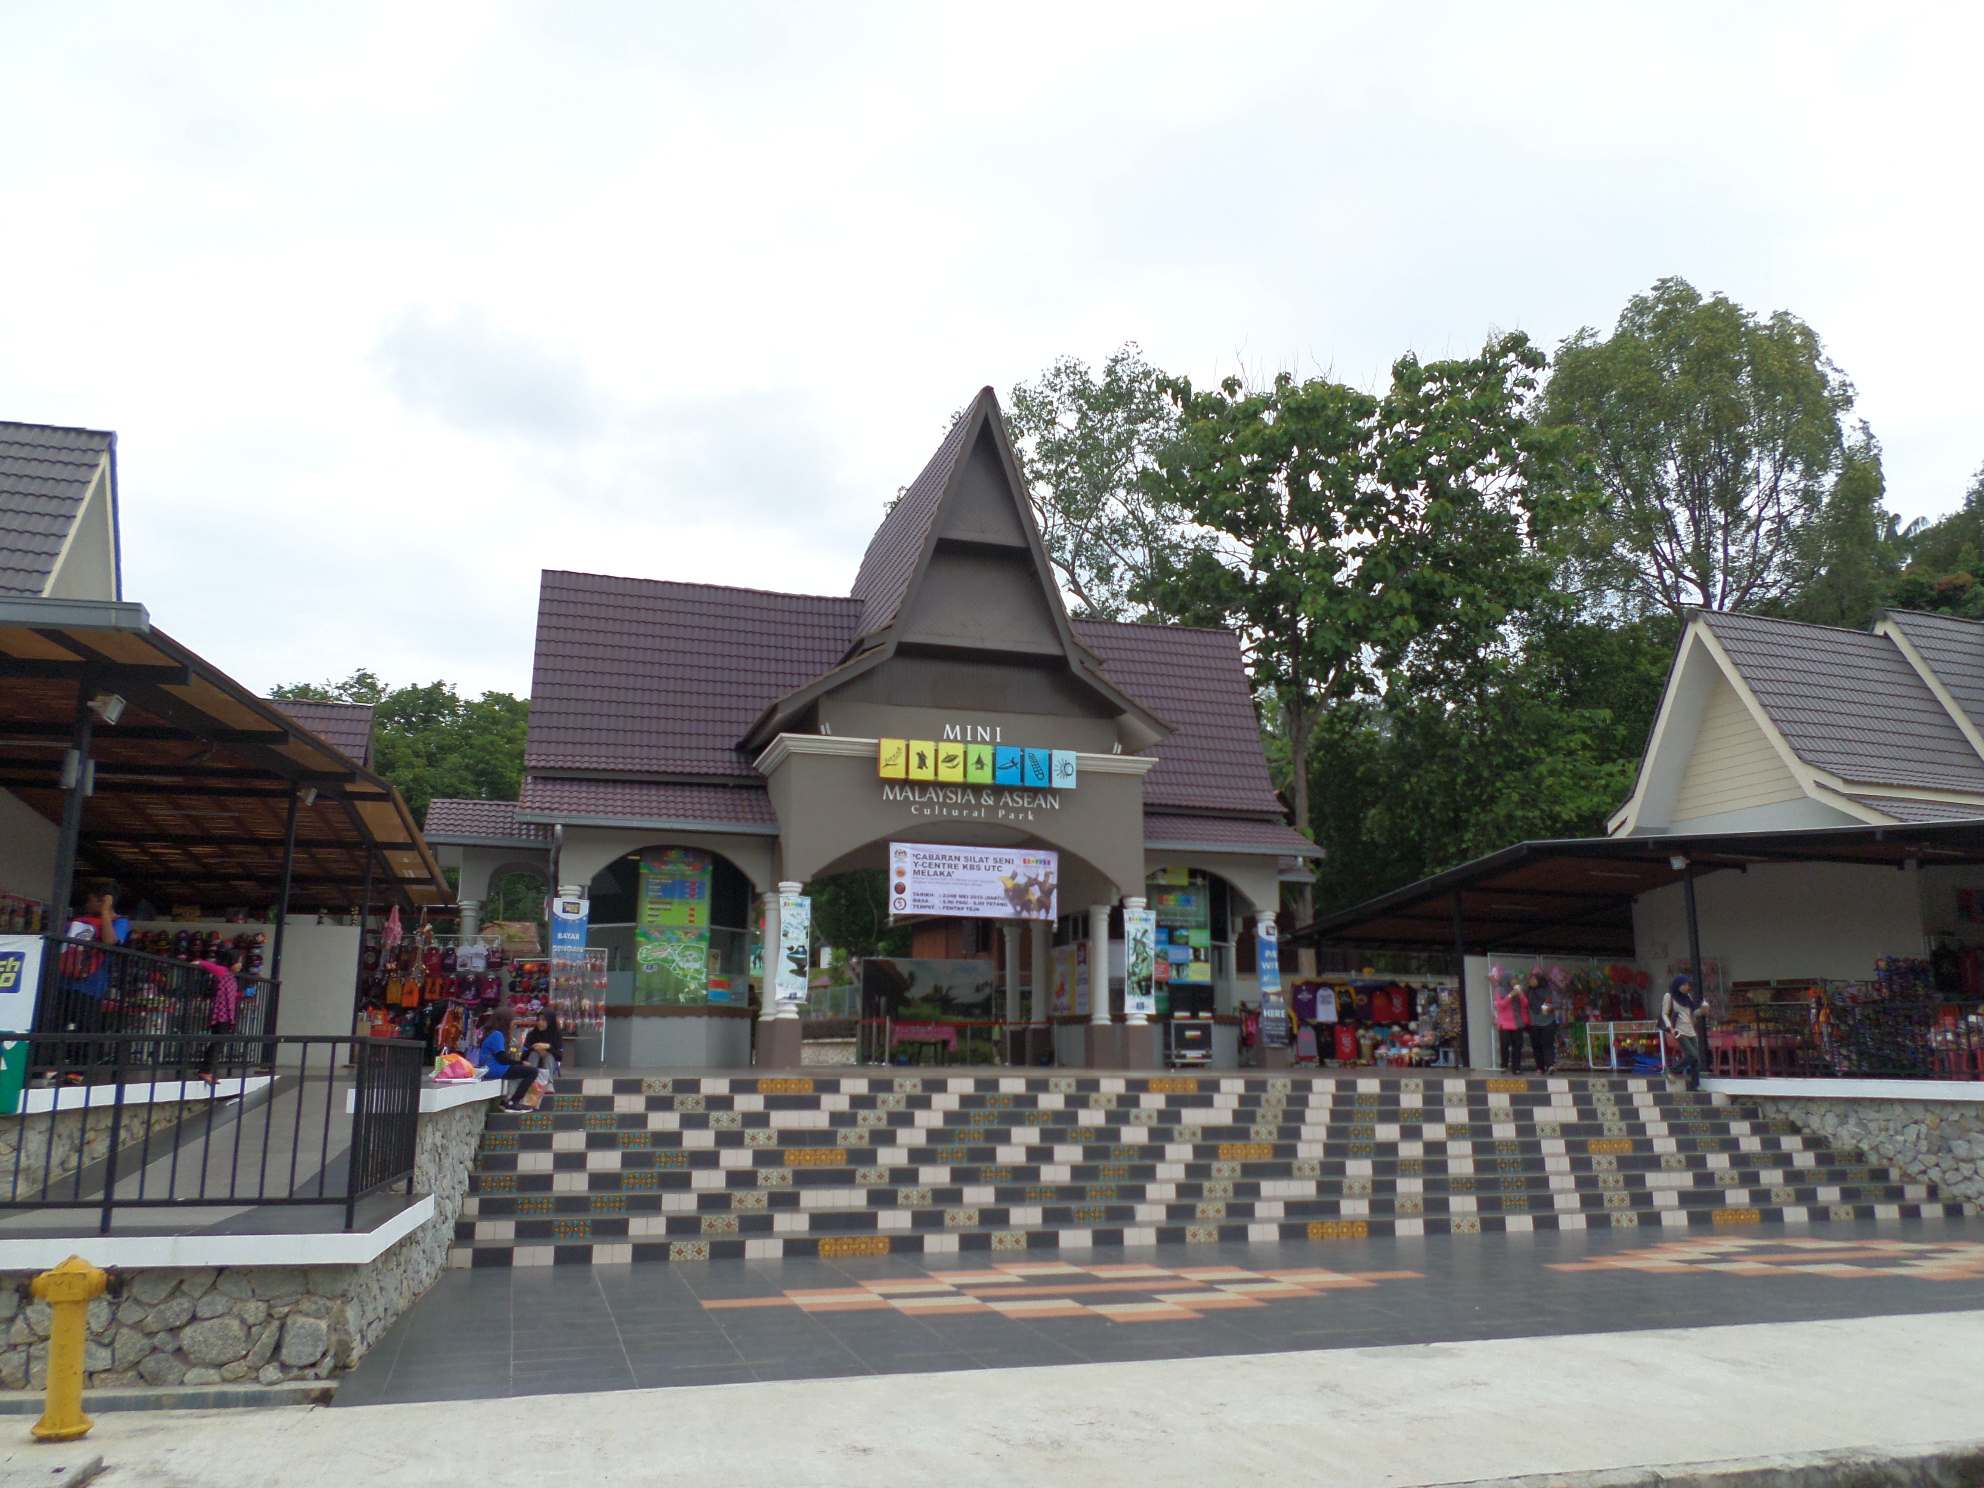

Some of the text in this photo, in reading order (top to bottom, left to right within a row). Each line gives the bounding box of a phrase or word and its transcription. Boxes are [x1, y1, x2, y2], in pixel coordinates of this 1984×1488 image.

[943, 724, 1002, 742] MINI
[882, 784, 1060, 810] MALAYSIA & ASEAN
[911, 805, 1034, 820] Cultural Park
[964, 855, 990, 864] SILAT
[993, 857, 1014, 865] SENI
[913, 861, 960, 870] Y-CENTRE
[557, 932, 580, 940] BAYAR
[1263, 1008, 1286, 1018] HERE
